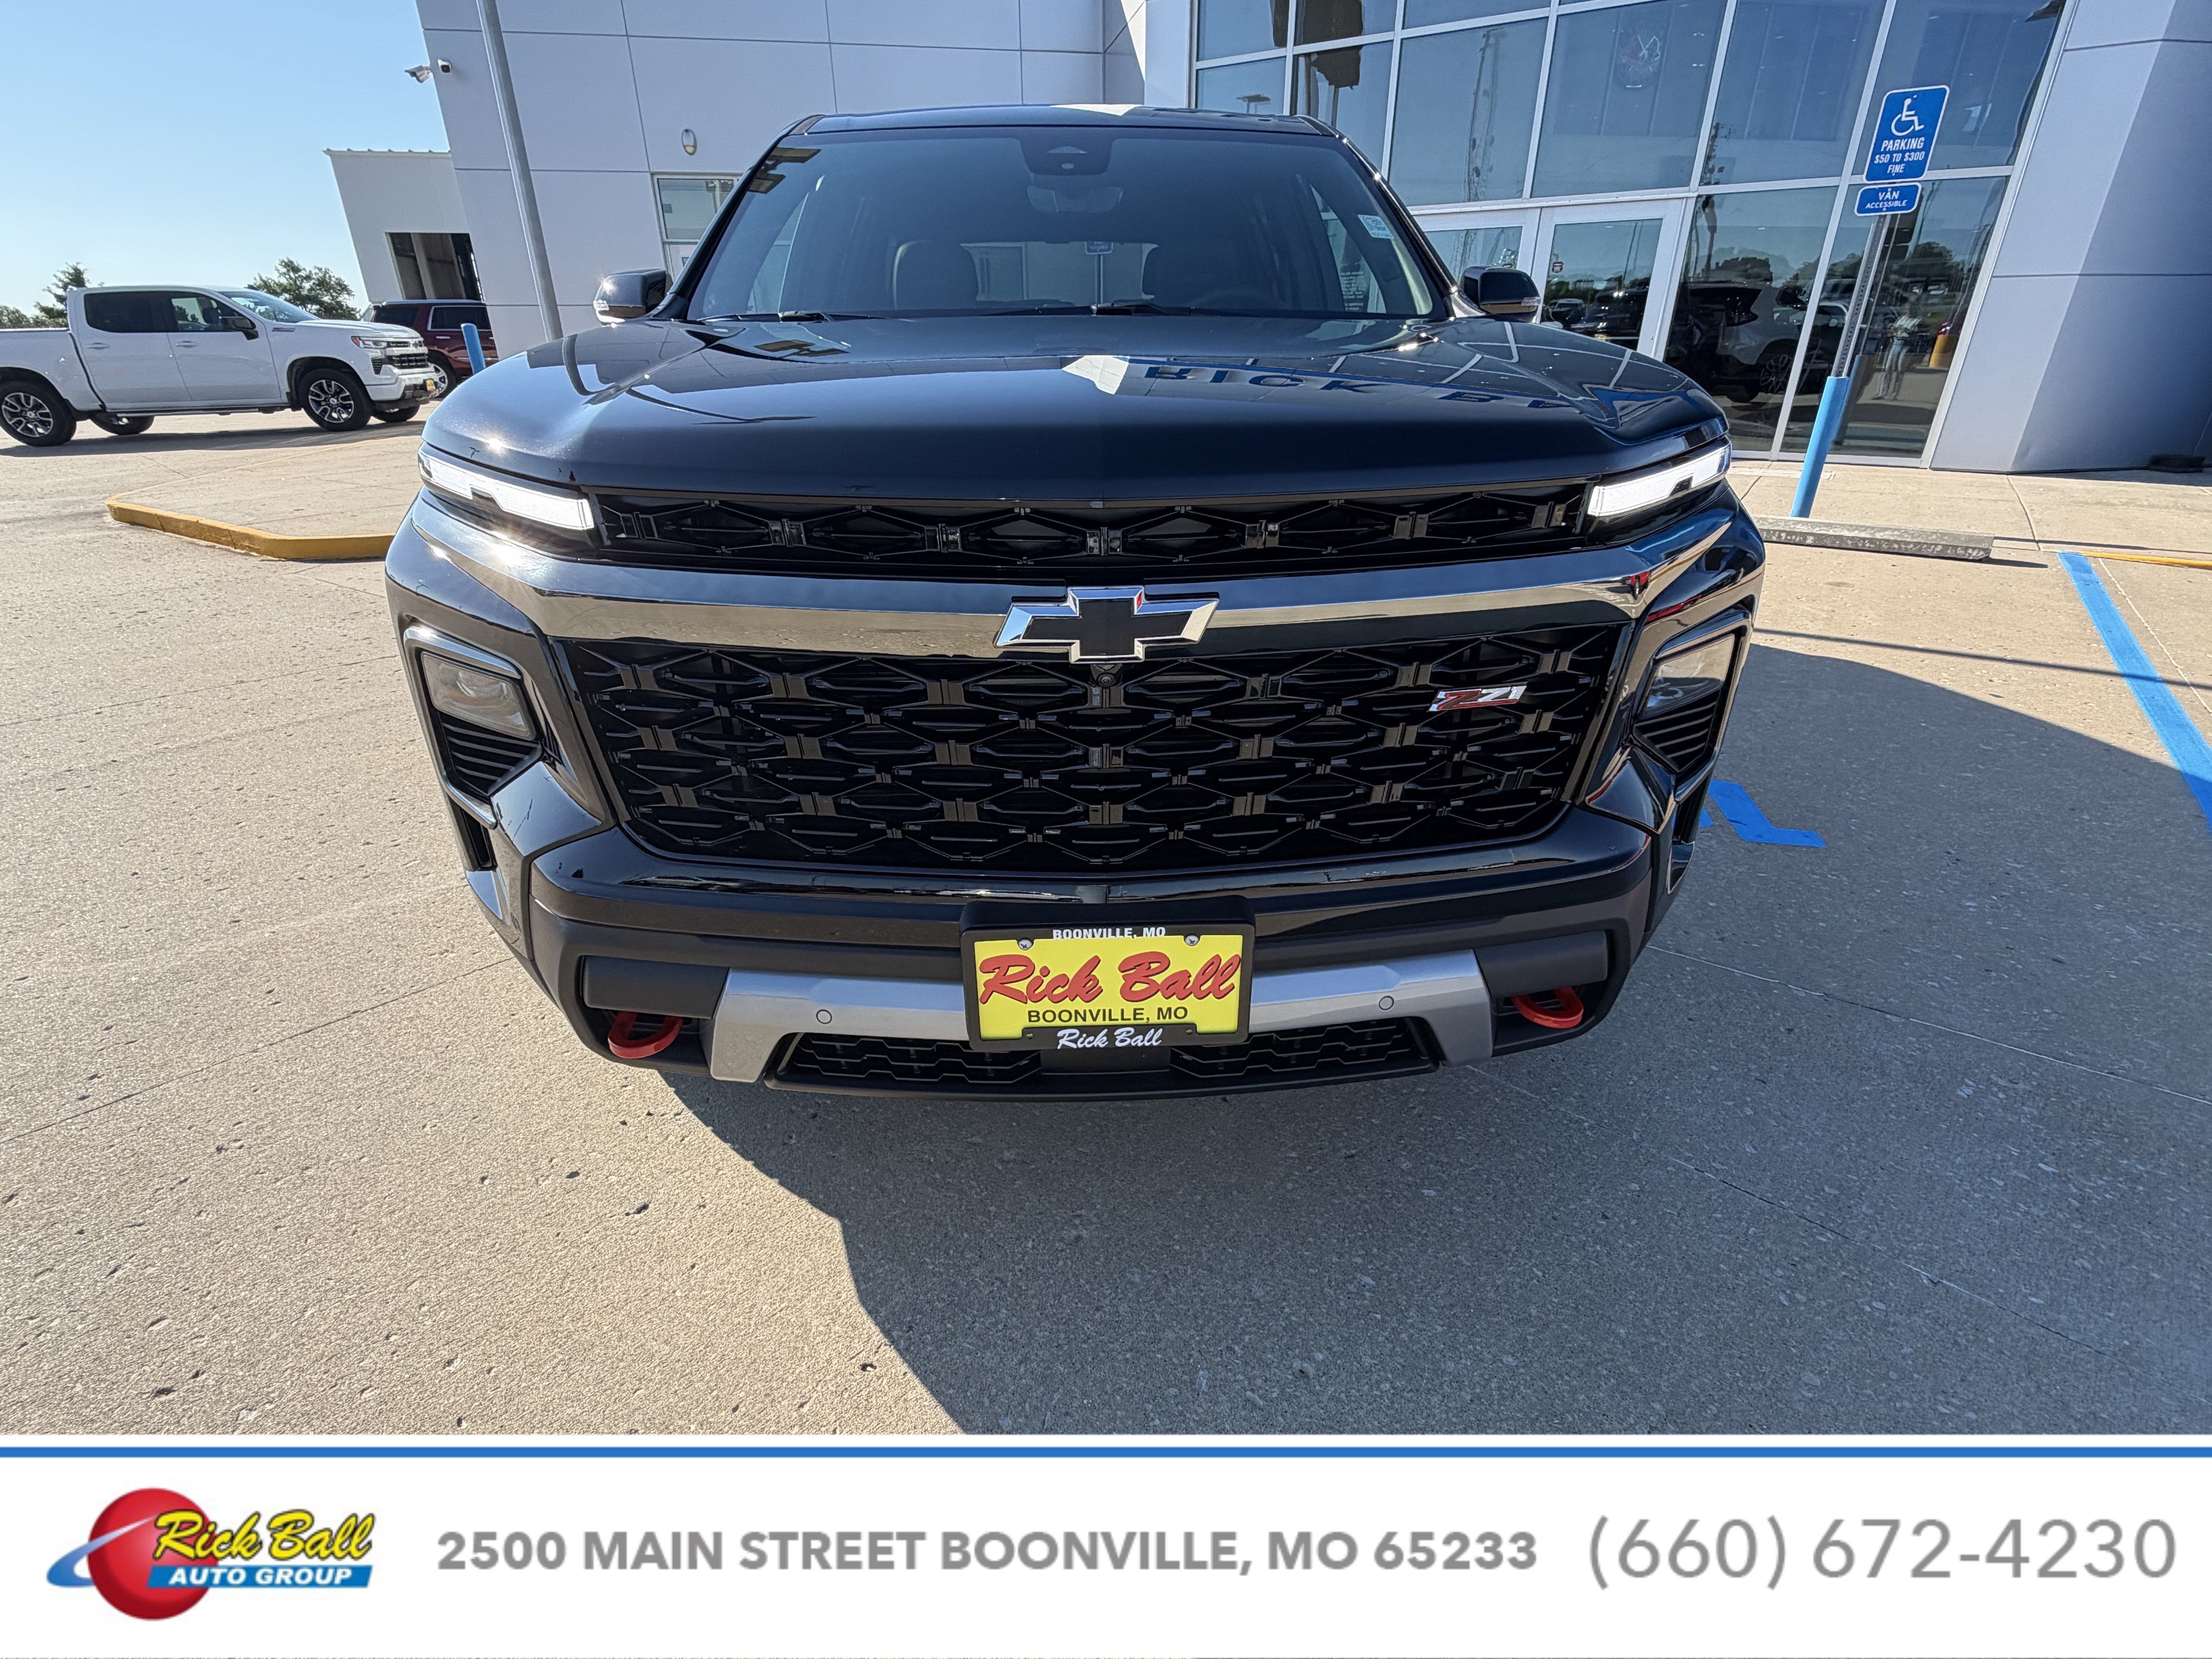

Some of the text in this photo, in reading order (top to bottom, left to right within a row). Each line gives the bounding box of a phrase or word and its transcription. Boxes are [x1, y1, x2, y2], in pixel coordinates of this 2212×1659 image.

[1881, 137, 1925, 152] PARKING
[1874, 151, 1925, 164] $50 TO $300
[1887, 163, 1905, 173] FINE
[1879, 191, 1900, 201] VAN
[1865, 199, 1908, 209] ACCESSIBLE
[1429, 685, 1527, 711] Z71
[1053, 927, 1166, 940] BOONVILLE, MO
[979, 951, 1241, 1004] Rick Ball
[1027, 1006, 1188, 1024] BOONVILLE, MO
[1057, 1027, 1163, 1049] Rick Ball
